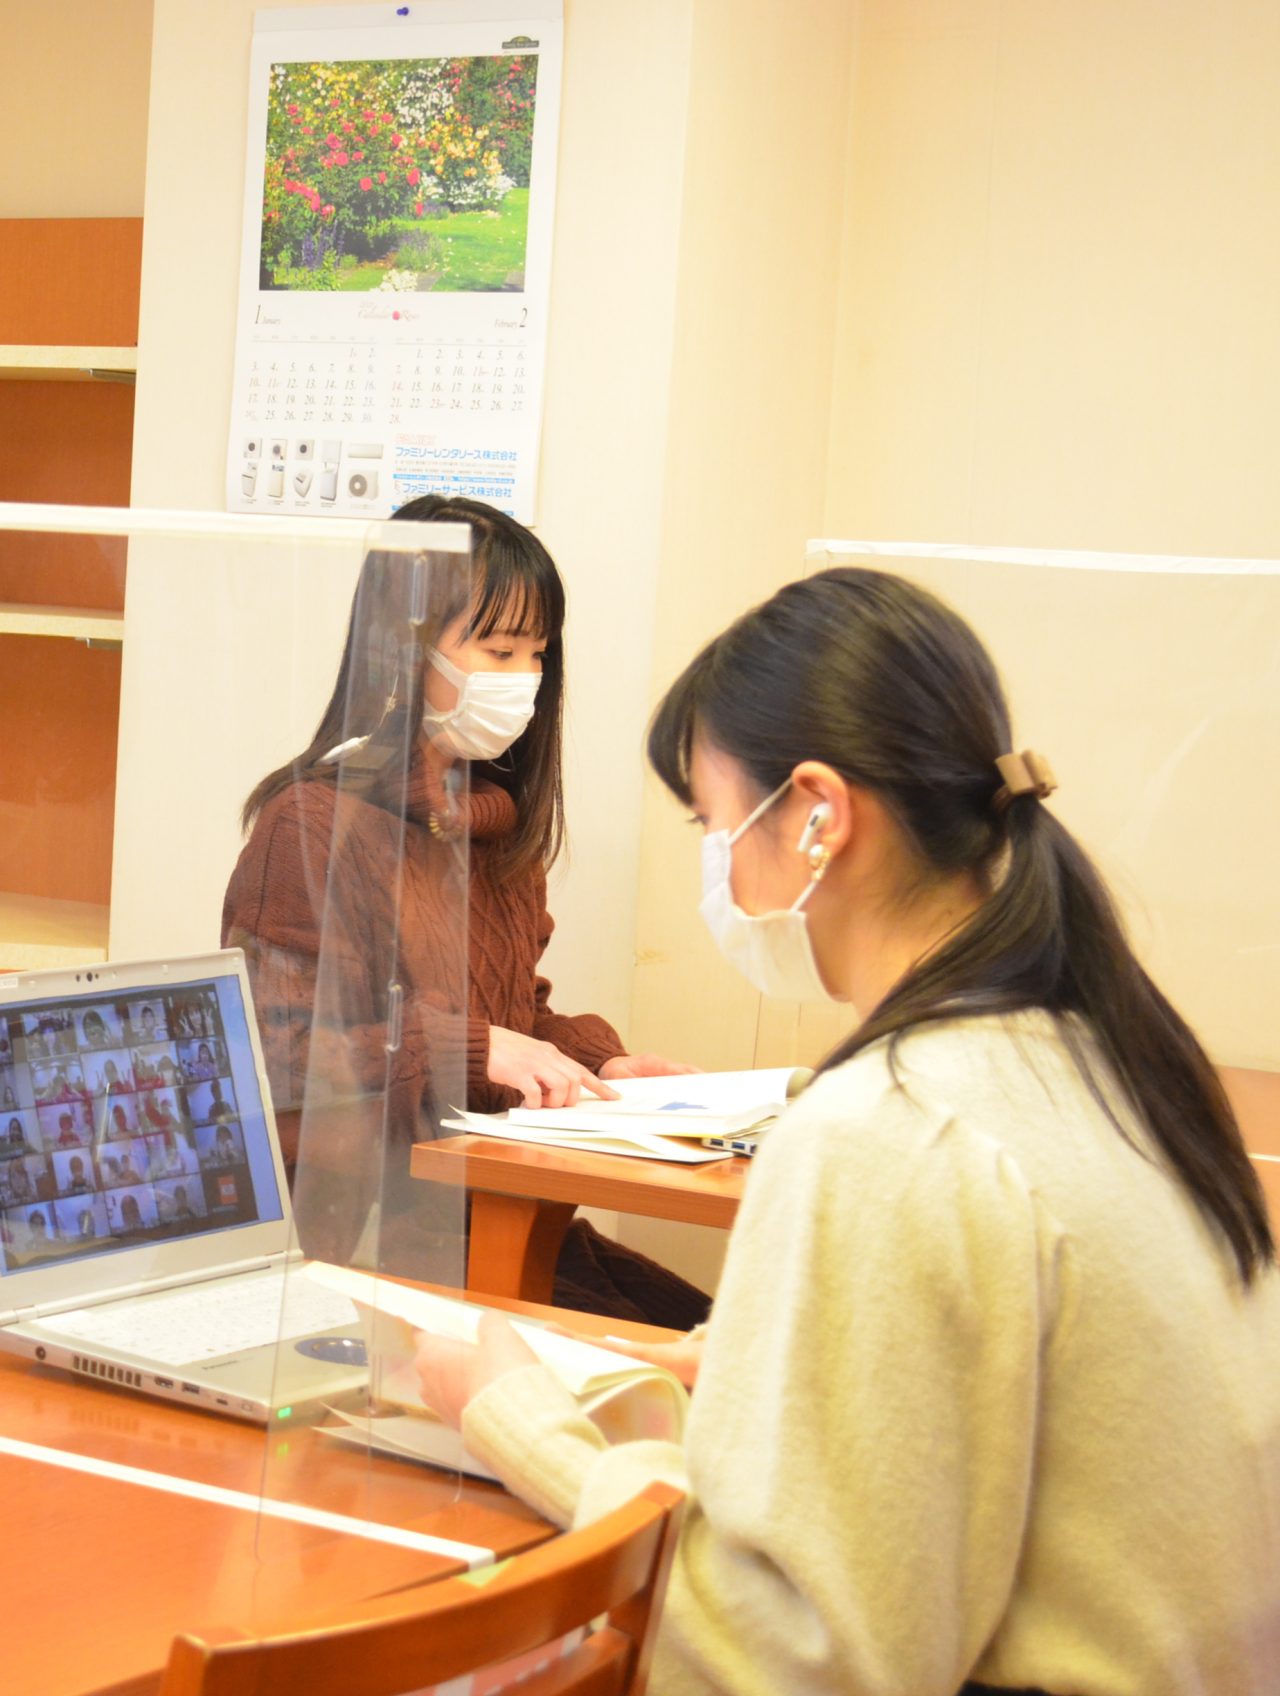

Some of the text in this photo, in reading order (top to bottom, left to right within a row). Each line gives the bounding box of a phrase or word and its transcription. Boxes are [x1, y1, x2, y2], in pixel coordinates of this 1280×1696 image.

[255, 304, 262, 324] 1
[519, 307, 528, 328] 2
[396, 447, 517, 461] ファミリーレンタリース株式会社
[402, 483, 512, 497] ファミリーサービス株式会社
